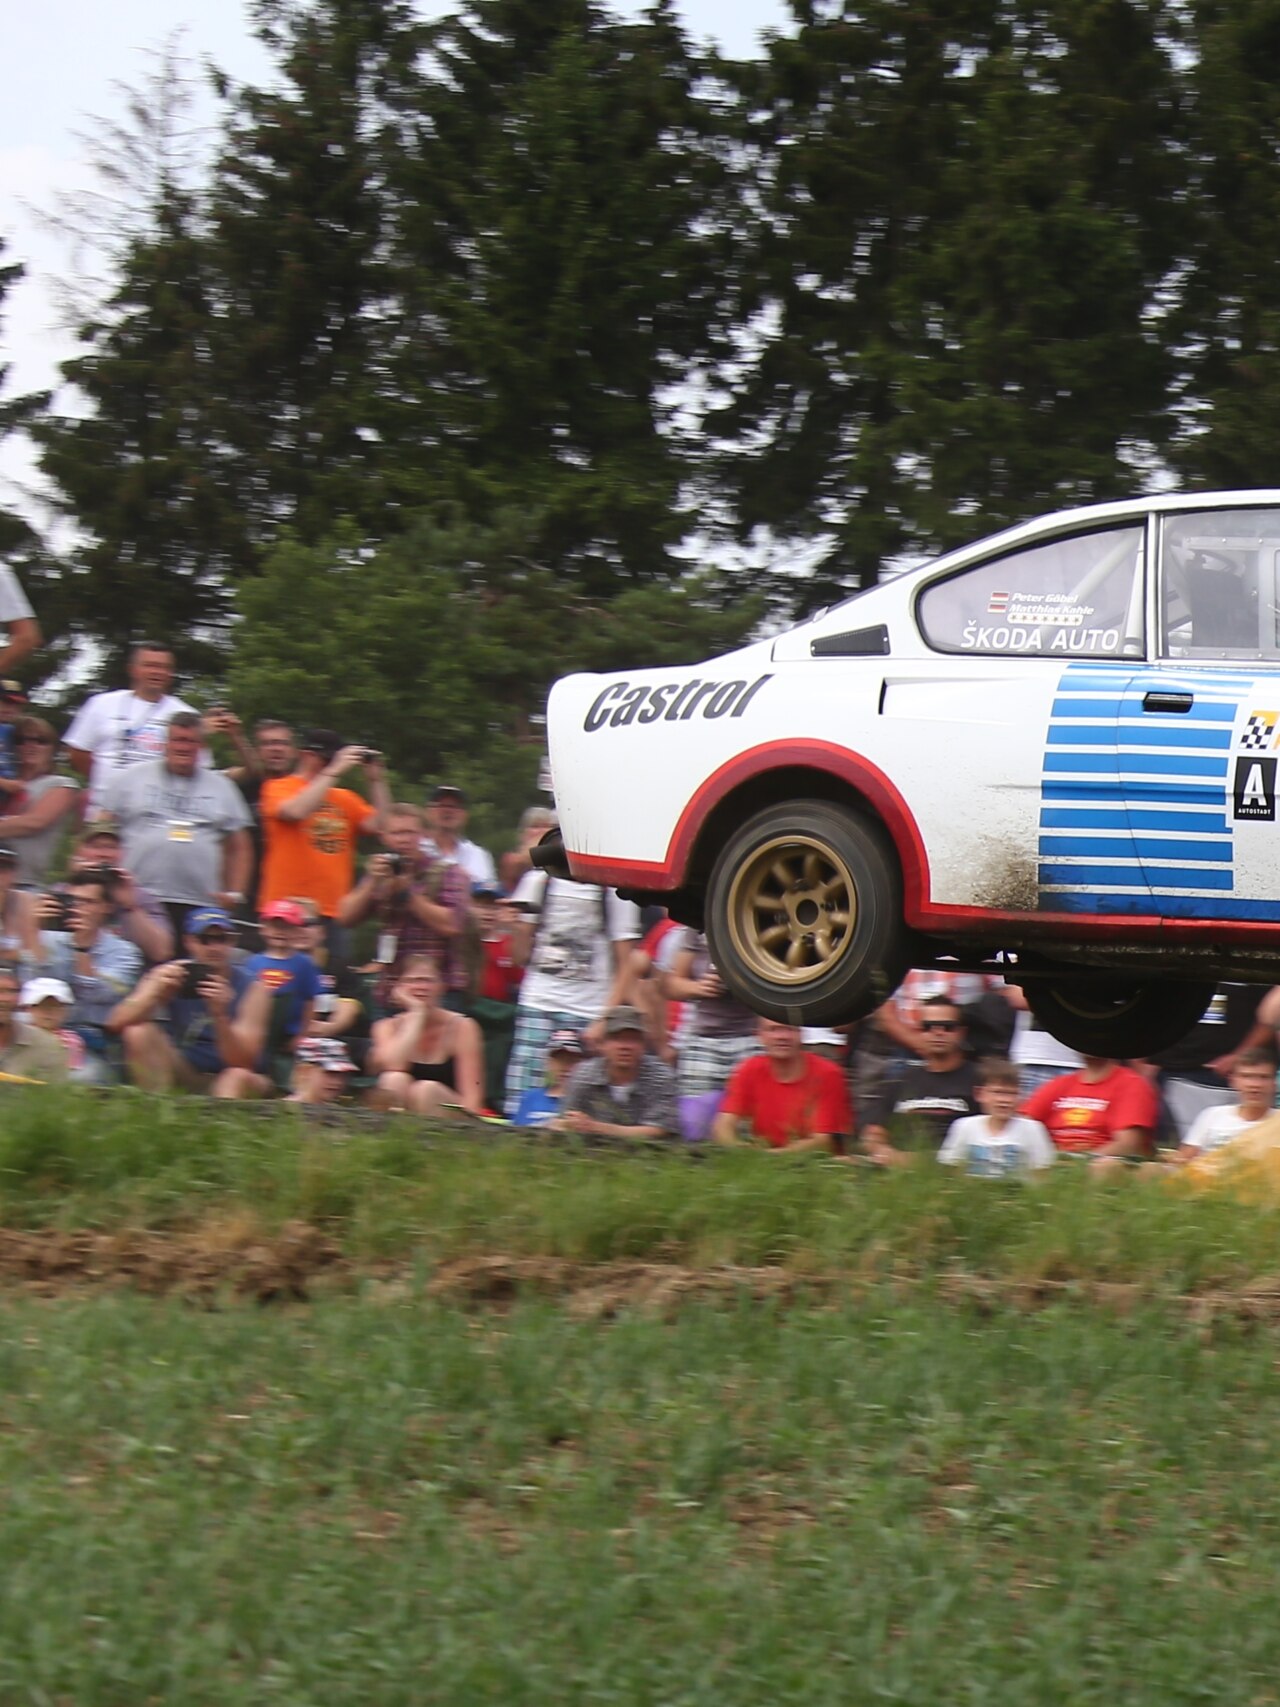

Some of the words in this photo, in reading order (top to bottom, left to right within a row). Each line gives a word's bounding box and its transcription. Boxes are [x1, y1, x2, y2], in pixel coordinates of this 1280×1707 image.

[1012, 592, 1045, 602] Peter
[1009, 604, 1061, 614] Matthias
[961, 620, 1042, 650] ŠKODA
[1051, 629, 1119, 651] AUTO
[583, 674, 775, 732] Castrol
[1242, 763, 1267, 806] A
[1238, 807, 1272, 816] AUTOSTADT
